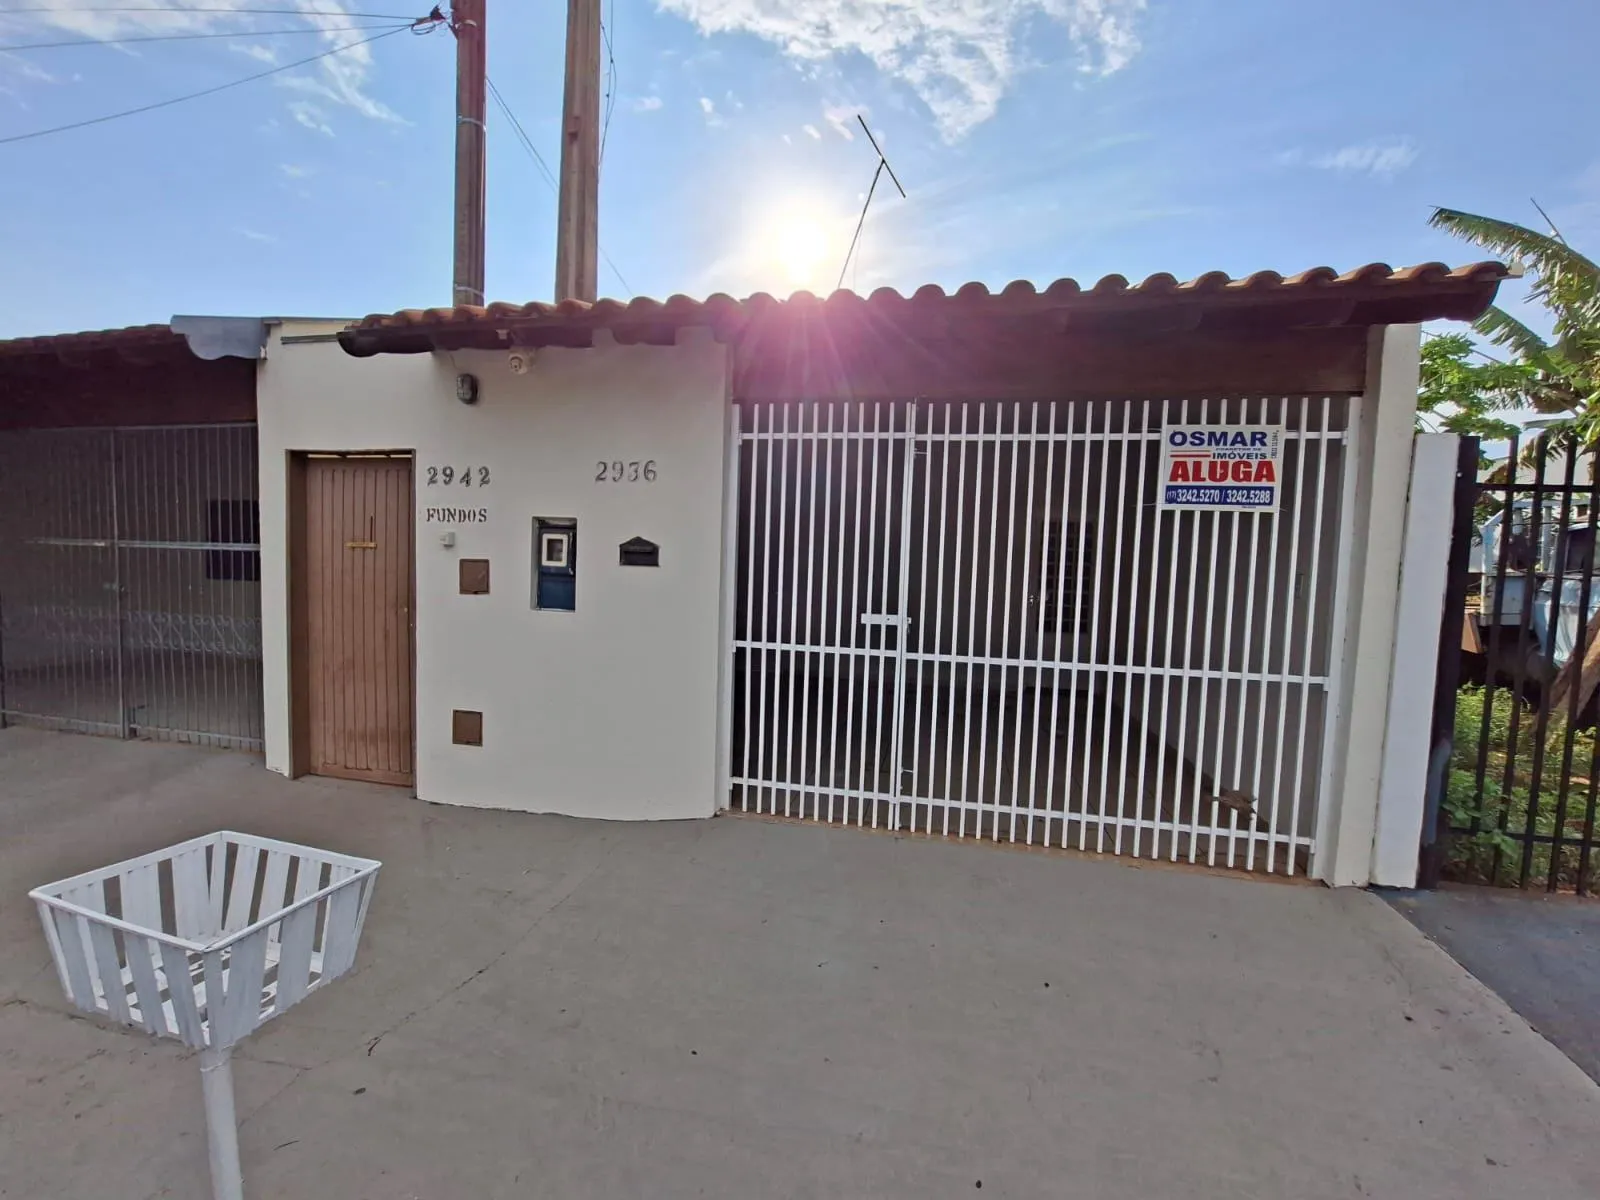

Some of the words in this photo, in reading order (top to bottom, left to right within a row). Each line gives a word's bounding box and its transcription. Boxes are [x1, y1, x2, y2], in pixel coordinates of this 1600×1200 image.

[1169, 431, 1268, 447] OSMAR
[1212, 451, 1268, 460] IMÓVEIS
[427, 466, 491, 487] 2942
[595, 460, 658, 483] 2936
[1168, 460, 1276, 482] ALUGA
[1176, 489, 1220, 502] 3242.5270
[1226, 490, 1270, 503] 3242.5288
[426, 507, 488, 523] FUNDOS
